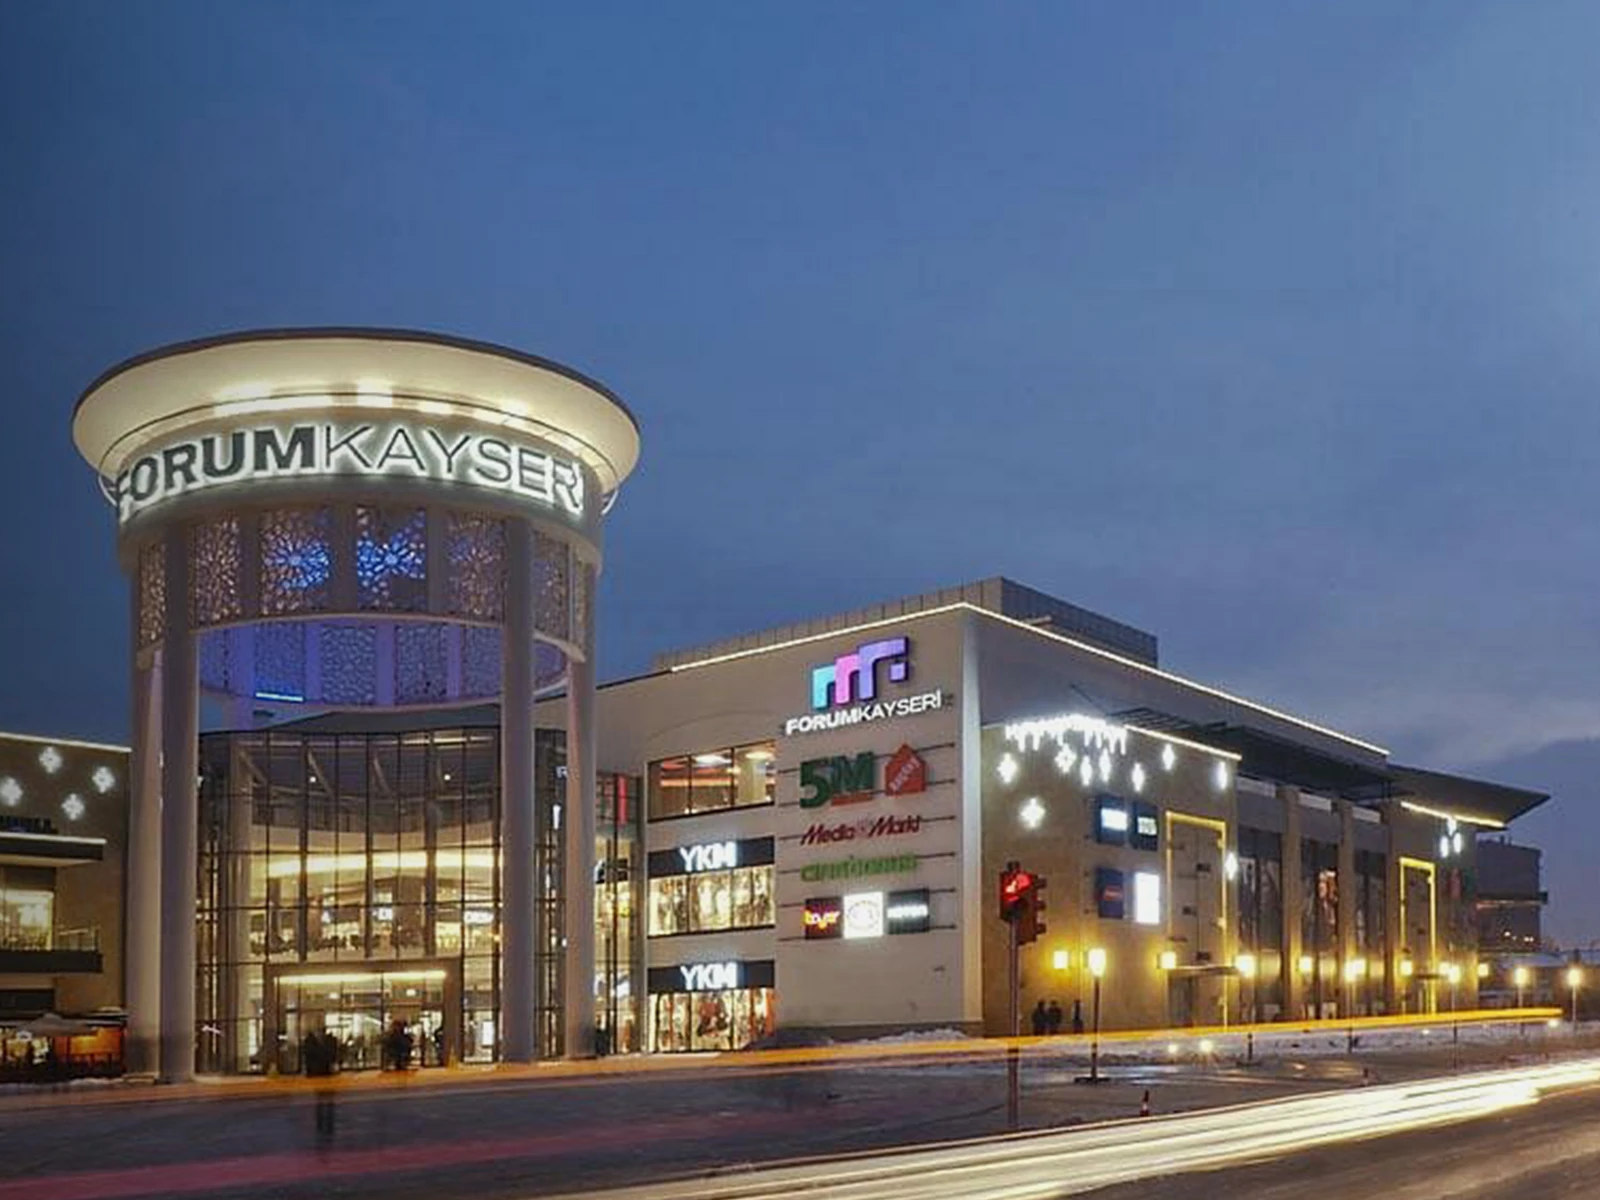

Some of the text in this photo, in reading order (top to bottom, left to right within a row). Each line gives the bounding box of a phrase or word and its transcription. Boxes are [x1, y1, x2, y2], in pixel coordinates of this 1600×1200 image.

[112, 425, 585, 521] FORUMKAYSER
[785, 689, 941, 735] FORUMKAYSERİ
[800, 751, 874, 808] 5M
[800, 815, 921, 846] Media Markt
[679, 842, 737, 872] YKM
[679, 961, 737, 990] YKM
